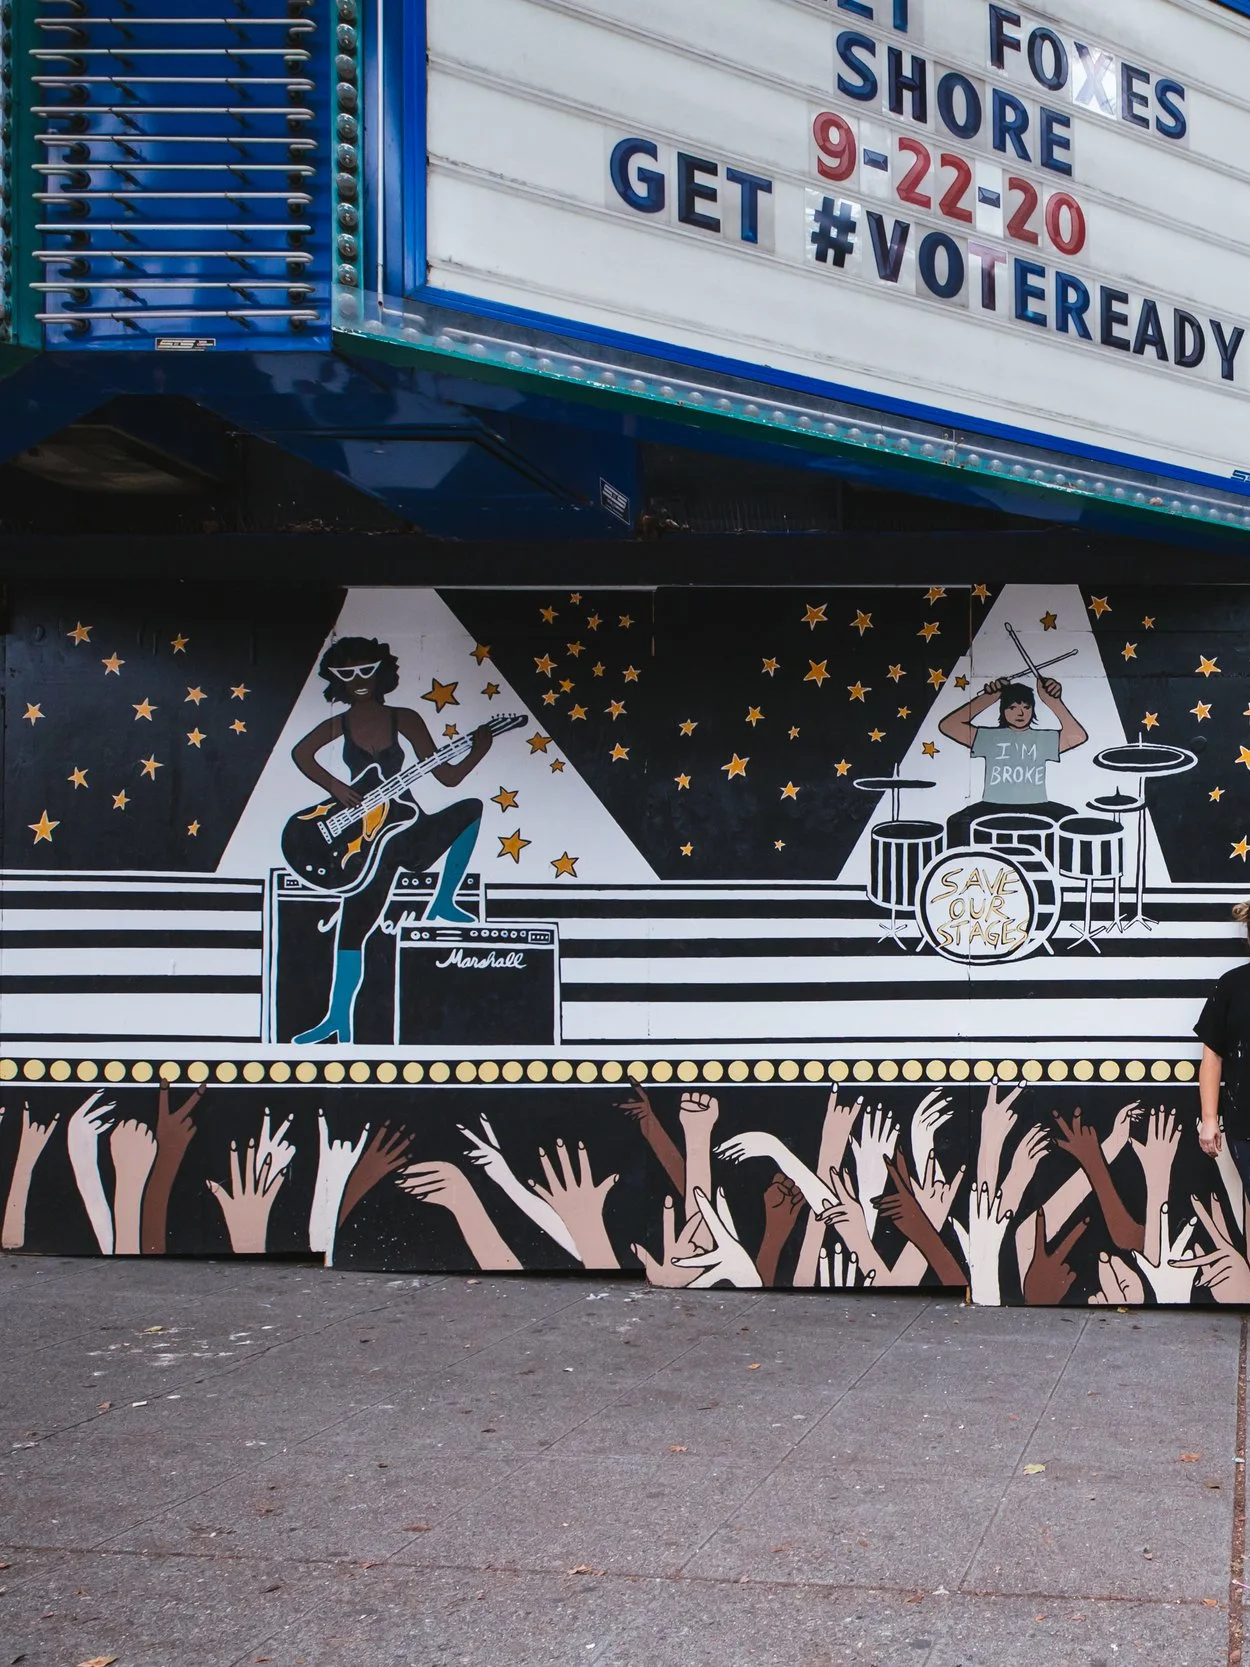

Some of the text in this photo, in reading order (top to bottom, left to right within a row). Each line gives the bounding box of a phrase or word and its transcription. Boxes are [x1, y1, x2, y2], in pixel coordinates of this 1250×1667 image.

[989, 4, 1187, 139] FOXES
[836, 31, 1073, 176] SHORE
[813, 111, 1086, 255] 9-22-20
[610, 137, 1245, 381] GET #VOTEREADY
[995, 742, 1037, 761] I'M
[989, 766, 1044, 785] BROKE
[930, 867, 1020, 904] SAVE
[949, 896, 1010, 922] OUR
[936, 919, 1029, 951] STAGES
[435, 949, 528, 969] Marshall
